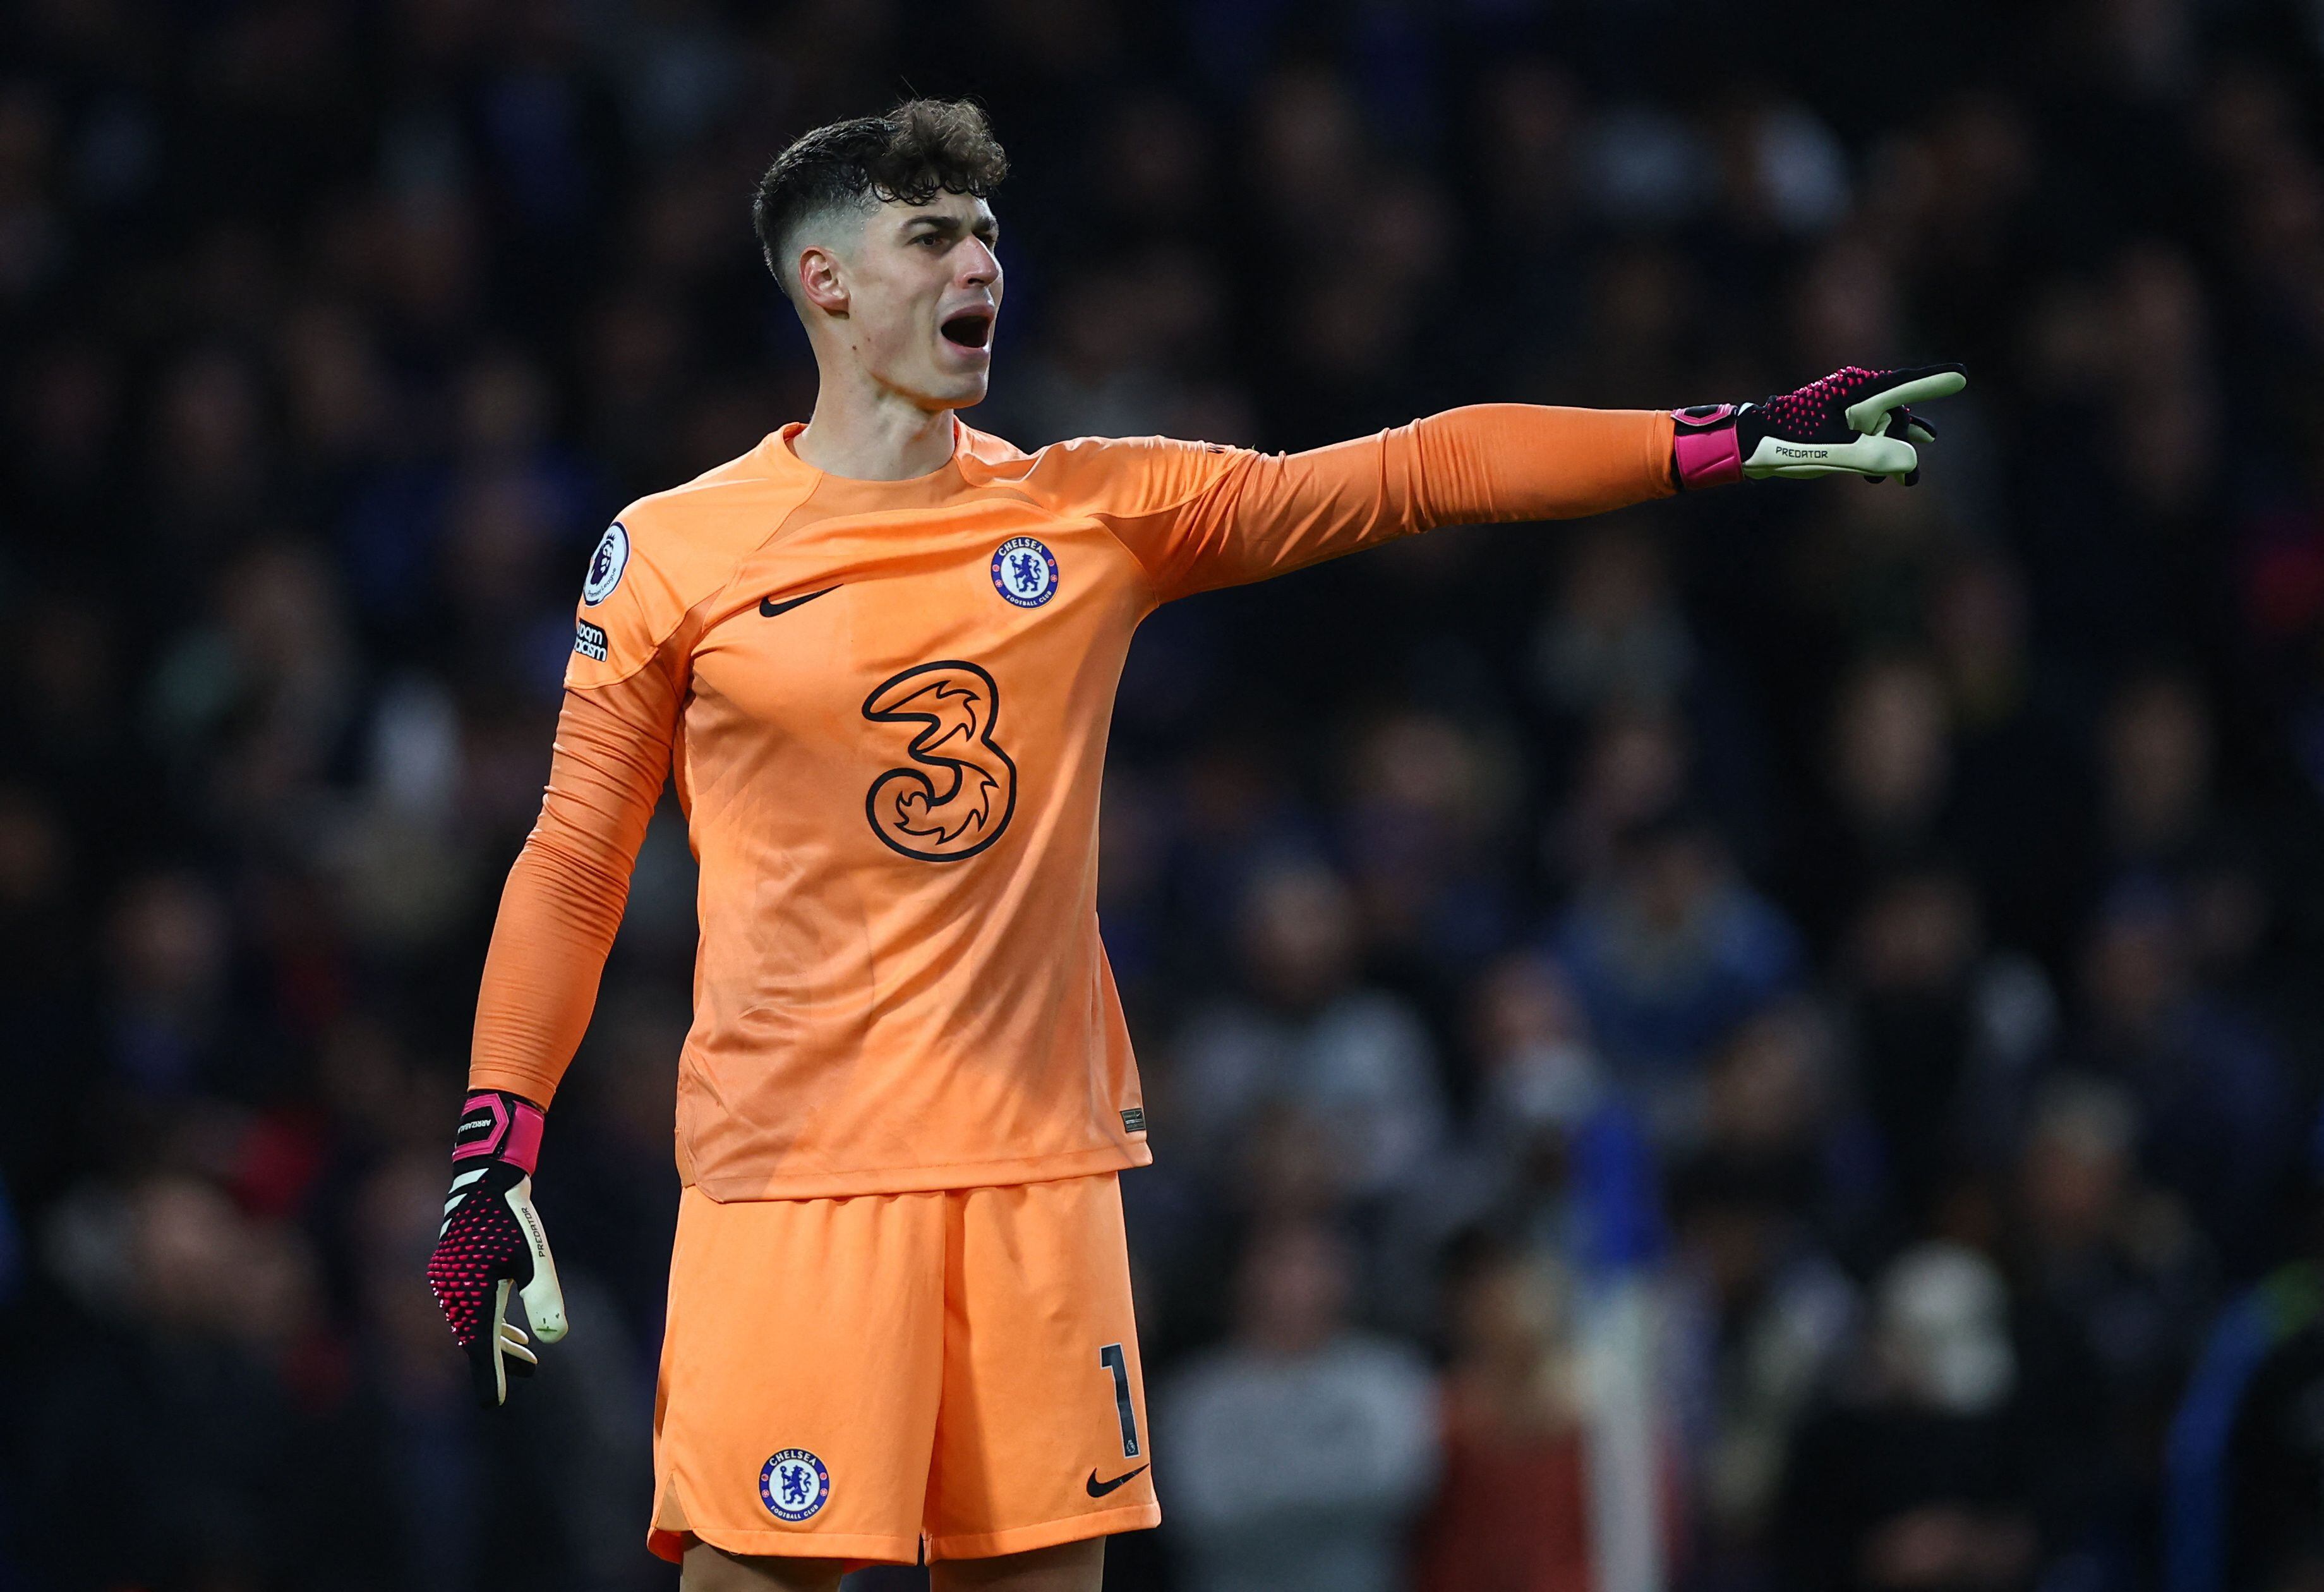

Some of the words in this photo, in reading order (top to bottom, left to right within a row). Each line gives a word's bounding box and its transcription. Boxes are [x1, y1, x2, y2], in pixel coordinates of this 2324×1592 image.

[1776, 446, 1828, 459] PREDATOR
[998, 538, 1044, 557] CHELSEA
[601, 567, 617, 591] League
[1006, 594, 1038, 606] FOOTBALL
[1039, 590, 1052, 603] CLUB
[862, 660, 1016, 862] 3
[521, 1207, 546, 1258] PREDATOR
[1100, 1342, 1141, 1459] 1
[769, 1450, 817, 1467] CHELSEA
[770, 1505, 802, 1520] FOOTBALL
[804, 1504, 819, 1517] CLUB
